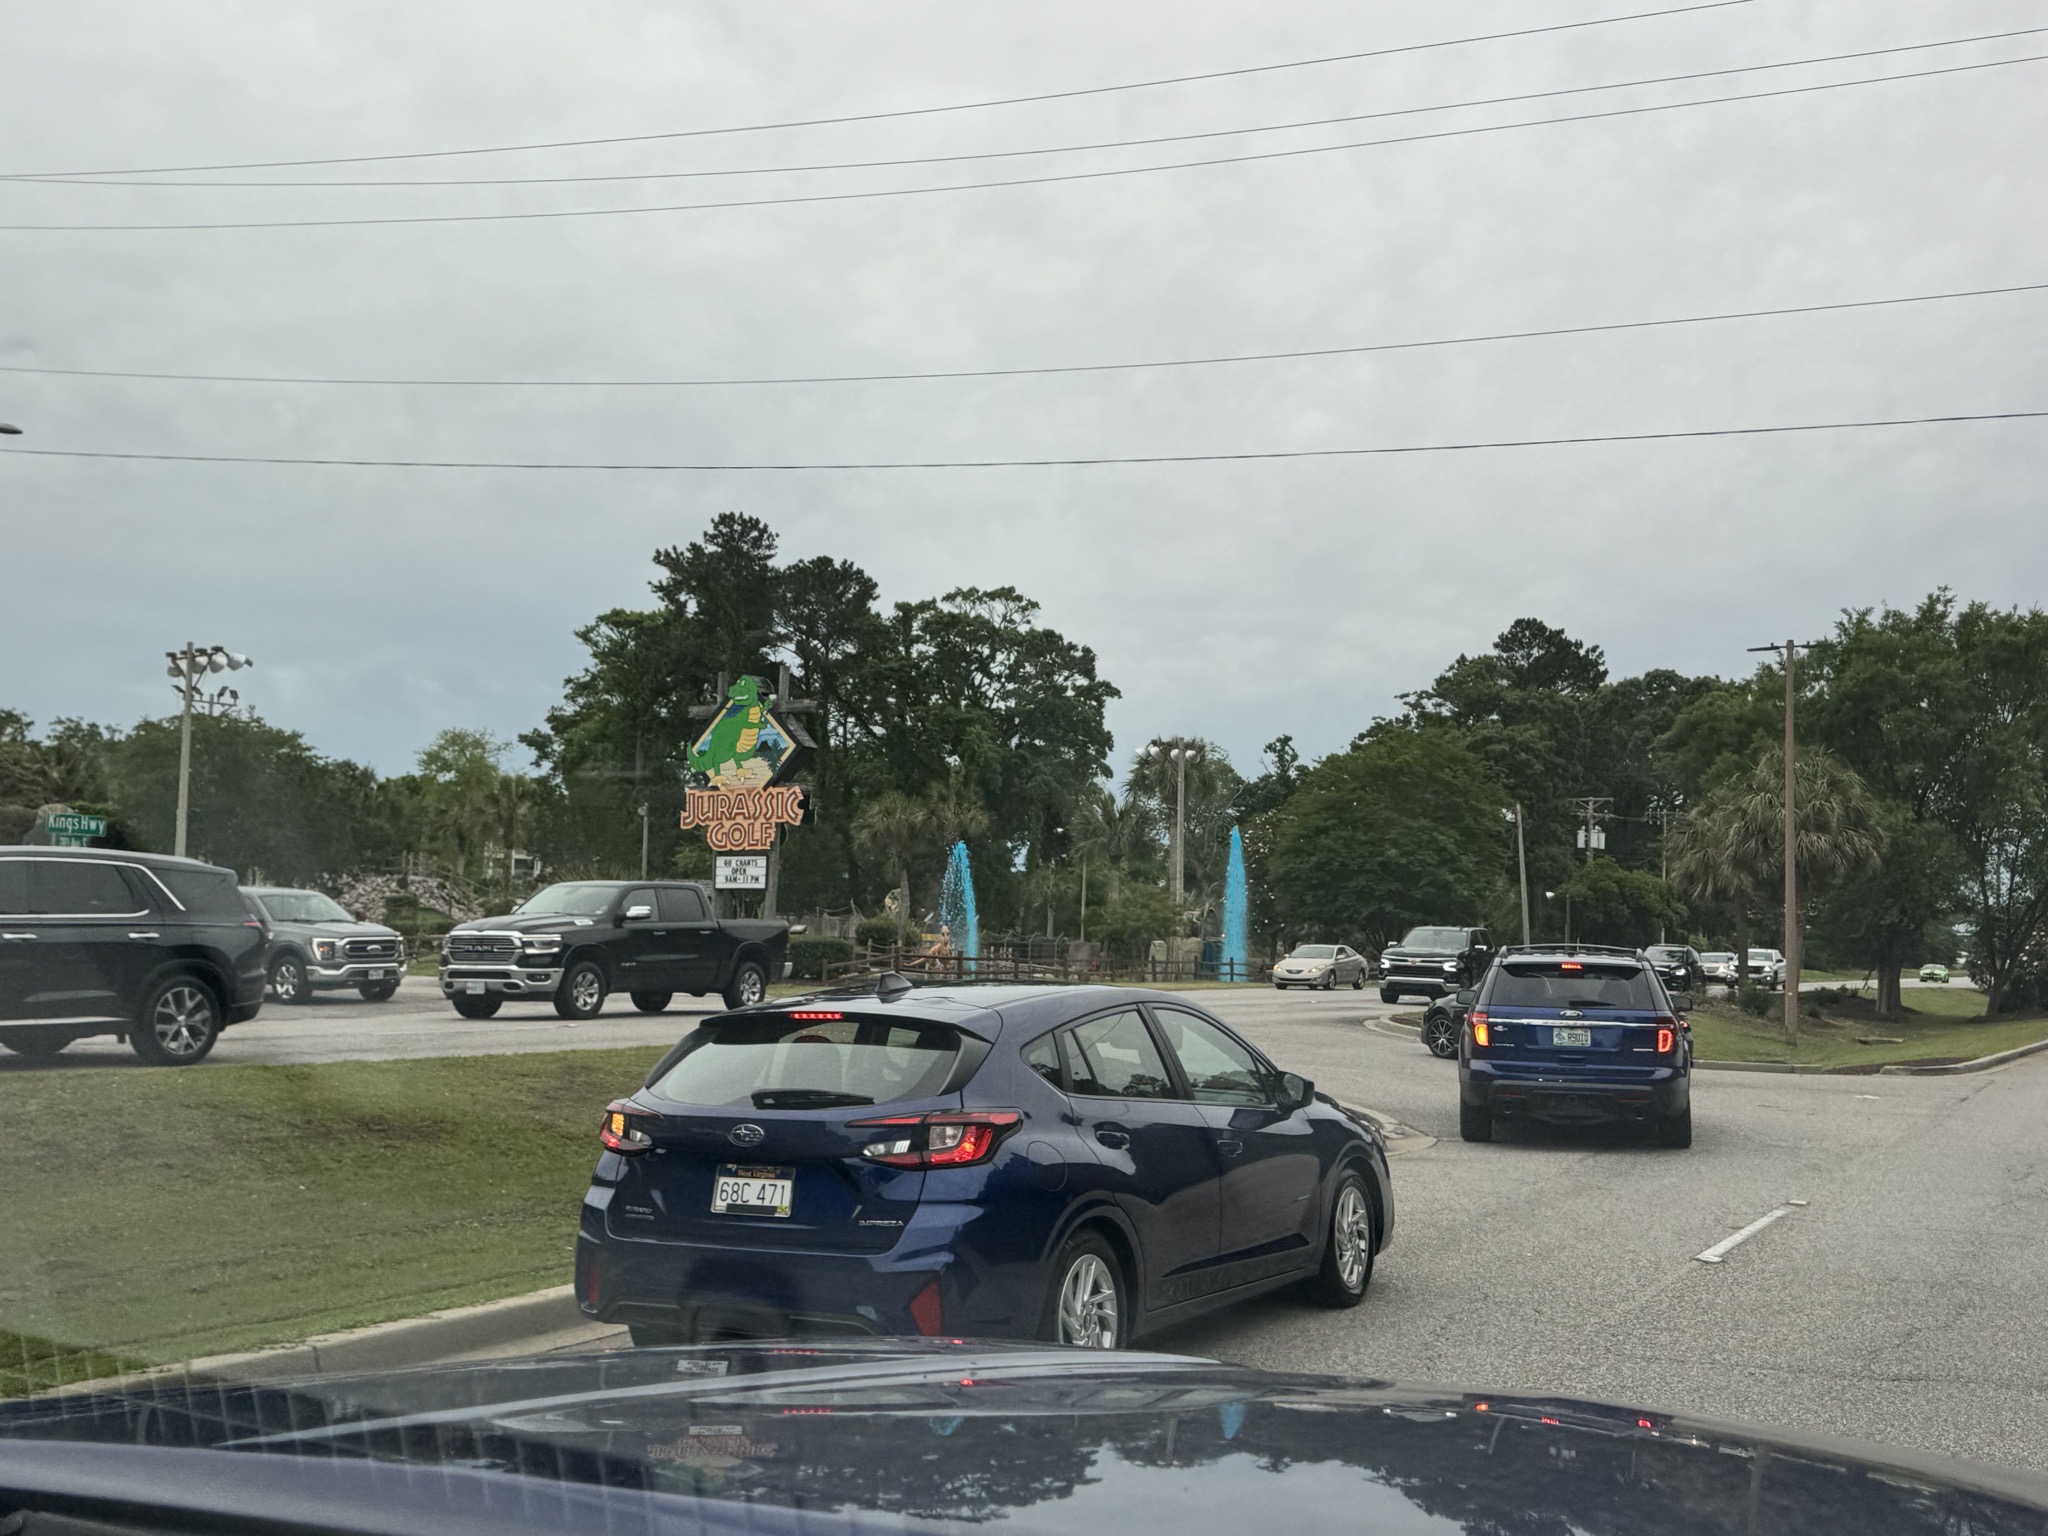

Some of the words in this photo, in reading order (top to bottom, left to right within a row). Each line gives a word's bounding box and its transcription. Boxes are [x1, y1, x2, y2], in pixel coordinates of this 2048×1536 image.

[682, 789, 800, 827] JURASSIC
[48, 814, 79, 833] Kings
[81, 816, 105, 835] Hwy
[709, 822, 773, 849] GOLF
[731, 867, 747, 875] OPEN
[720, 1181, 751, 1204] 68C
[756, 1183, 785, 1206] 471
